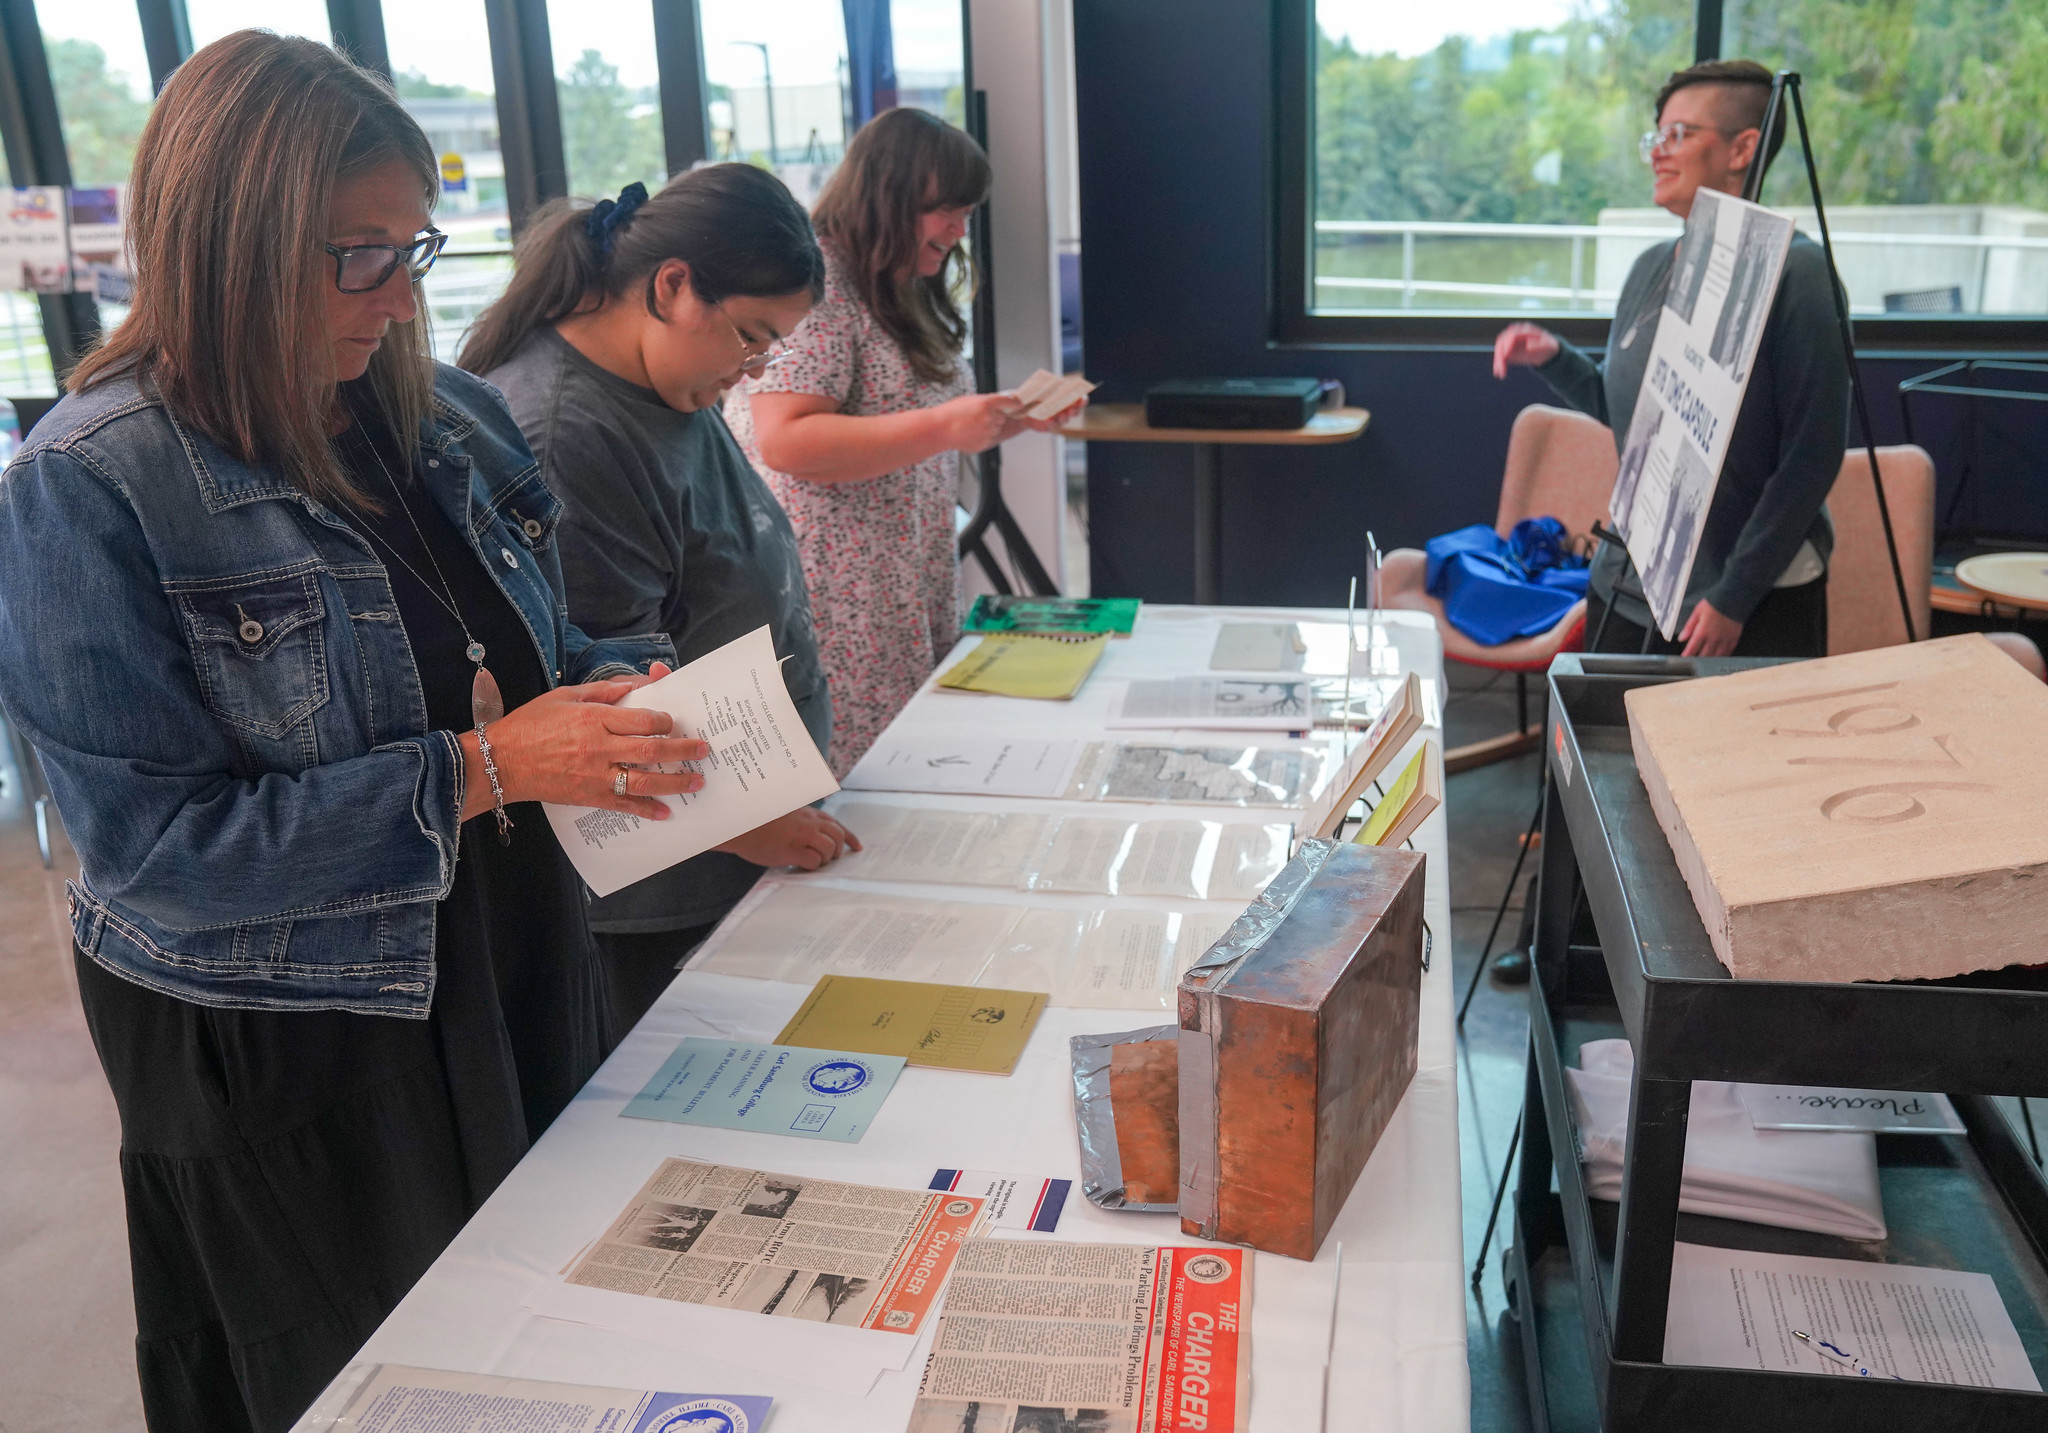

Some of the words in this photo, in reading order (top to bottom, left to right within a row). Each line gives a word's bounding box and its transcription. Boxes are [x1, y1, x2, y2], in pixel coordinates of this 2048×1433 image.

[1680, 387, 1718, 455] CAPSULE
[729, 712, 737, 726] LEWIS
[742, 698, 755, 717] BOARD
[751, 716, 759, 726] OF
[755, 725, 770, 750] TRUSTEES
[749, 667, 764, 700] COMMUNITY
[760, 700, 775, 724] COLLEGE
[771, 724, 787, 748] DISTRICT
[788, 758, 797, 769] 518
[726, 755, 735, 767] GARY
[1749, 680, 2000, 826] 1976
[723, 1047, 739, 1057] JOB
[737, 1049, 753, 1061] AND
[746, 1049, 769, 1070] CAREER
[773, 1052, 791, 1064] Carl
[701, 1058, 732, 1088] PLACEMENT
[751, 1065, 782, 1093] Sandburg
[726, 1070, 754, 1098] PLANNING
[680, 1090, 707, 1114] BULLETIN
[734, 1094, 762, 1117] College
[984, 1181, 996, 1196] viewing
[997, 1179, 1007, 1190] please
[1002, 1187, 1013, 1202] original
[921, 1193, 933, 1203] New
[907, 1204, 927, 1225] Parking
[934, 1211, 943, 1219] THE
[773, 1220, 797, 1240] Army
[903, 1226, 915, 1235] Lot
[920, 1219, 939, 1245] NEWSPAPER
[949, 1225, 968, 1243] THE
[759, 1240, 783, 1264] ROTC
[891, 1235, 909, 1253] Brings
[876, 1253, 899, 1280] Problems
[903, 1230, 952, 1294] CHARGER
[909, 1252, 921, 1265] CARL
[1141, 1247, 1155, 1265] New
[894, 1265, 914, 1291] SANDBURG
[1158, 1264, 1168, 1282] Sandburg
[1175, 1276, 1185, 1291] THE
[716, 1281, 734, 1298] Seeks
[1132, 1267, 1153, 1304] Parking
[882, 1291, 900, 1312] COLLEGE
[1132, 1305, 1148, 1322] Lot
[1169, 1291, 1183, 1337] NEWSPAPER
[1217, 1302, 1237, 1332] THE
[1125, 1325, 1146, 1353] Brings
[1168, 1339, 1179, 1349] OF
[1147, 1363, 1156, 1374] Vol.
[1166, 1350, 1177, 1372] CARL
[1177, 1311, 1215, 1430] CHARGER
[1120, 1355, 1142, 1407] Problems
[716, 1403, 736, 1415] CARL
[1160, 1374, 1175, 1427] SANDBURG
